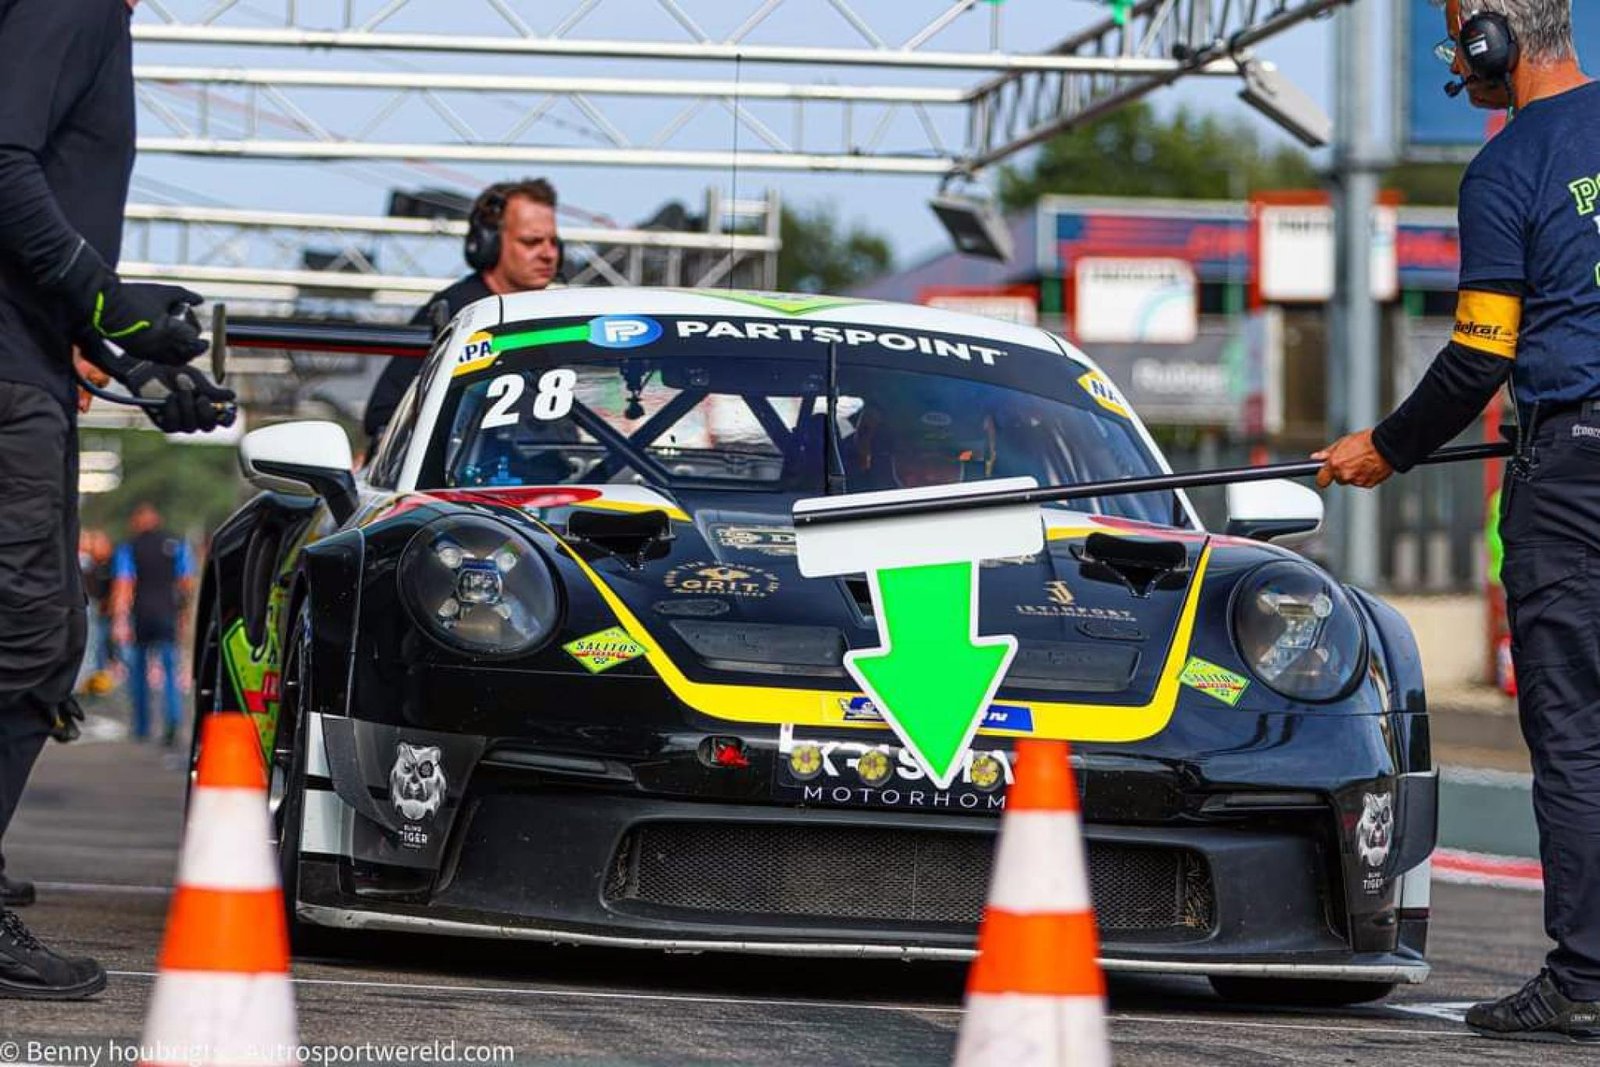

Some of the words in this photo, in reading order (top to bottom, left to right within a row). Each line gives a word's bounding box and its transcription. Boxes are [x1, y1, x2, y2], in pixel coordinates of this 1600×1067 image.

[676, 320, 1007, 365] PARTSPOINT
[480, 368, 577, 429] 28
[804, 785, 1006, 809] MOTORHOM
